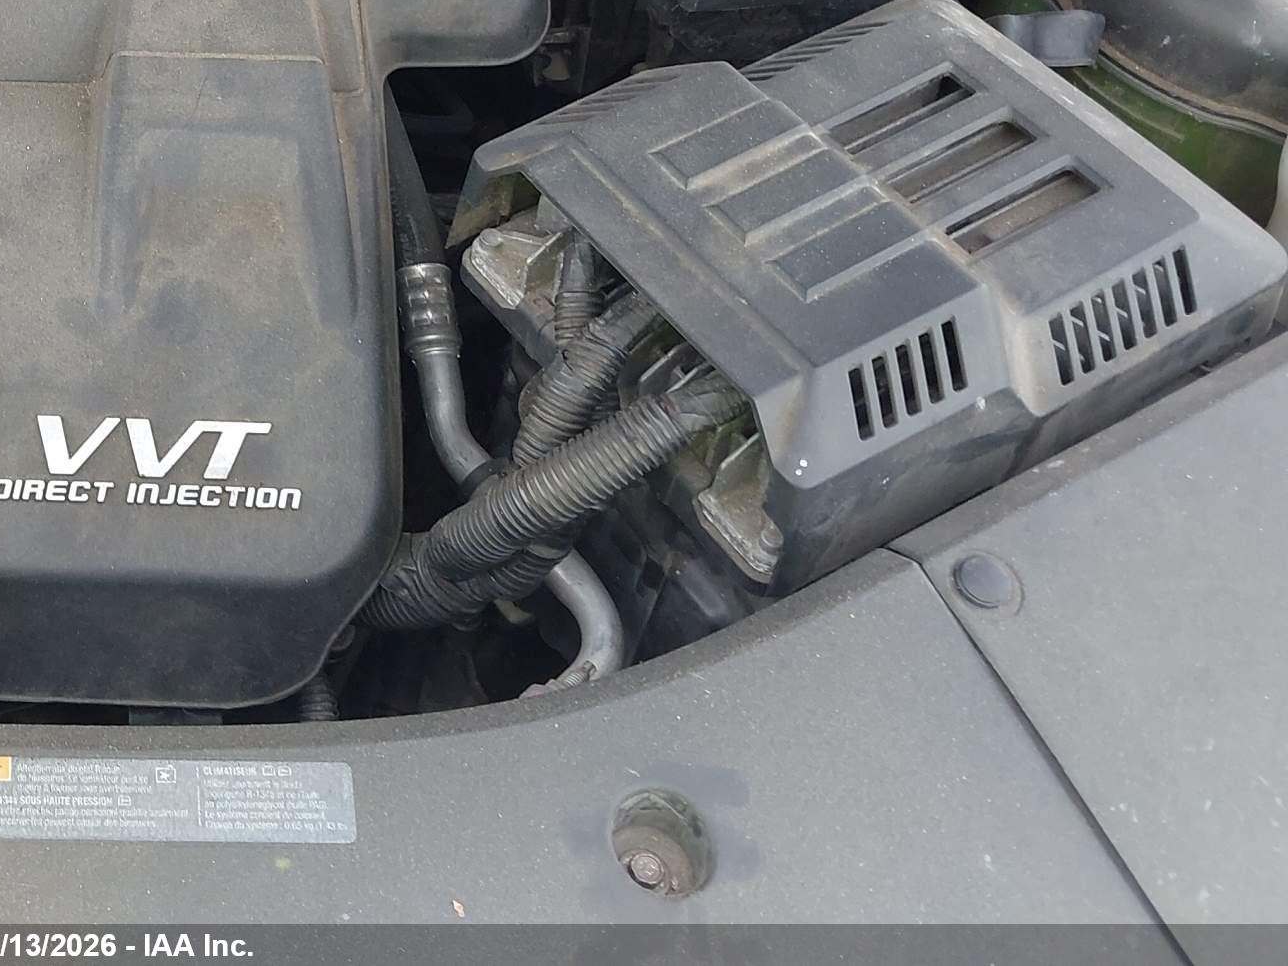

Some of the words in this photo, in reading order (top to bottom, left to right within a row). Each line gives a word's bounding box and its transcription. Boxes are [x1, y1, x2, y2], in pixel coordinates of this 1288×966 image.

[36, 414, 273, 480] VVT
[126, 482, 302, 509] INJECTION
[20, 795, 42, 806] SOUS
[44, 795, 70, 806] HAUTE
[72, 796, 113, 807] PRESSION
